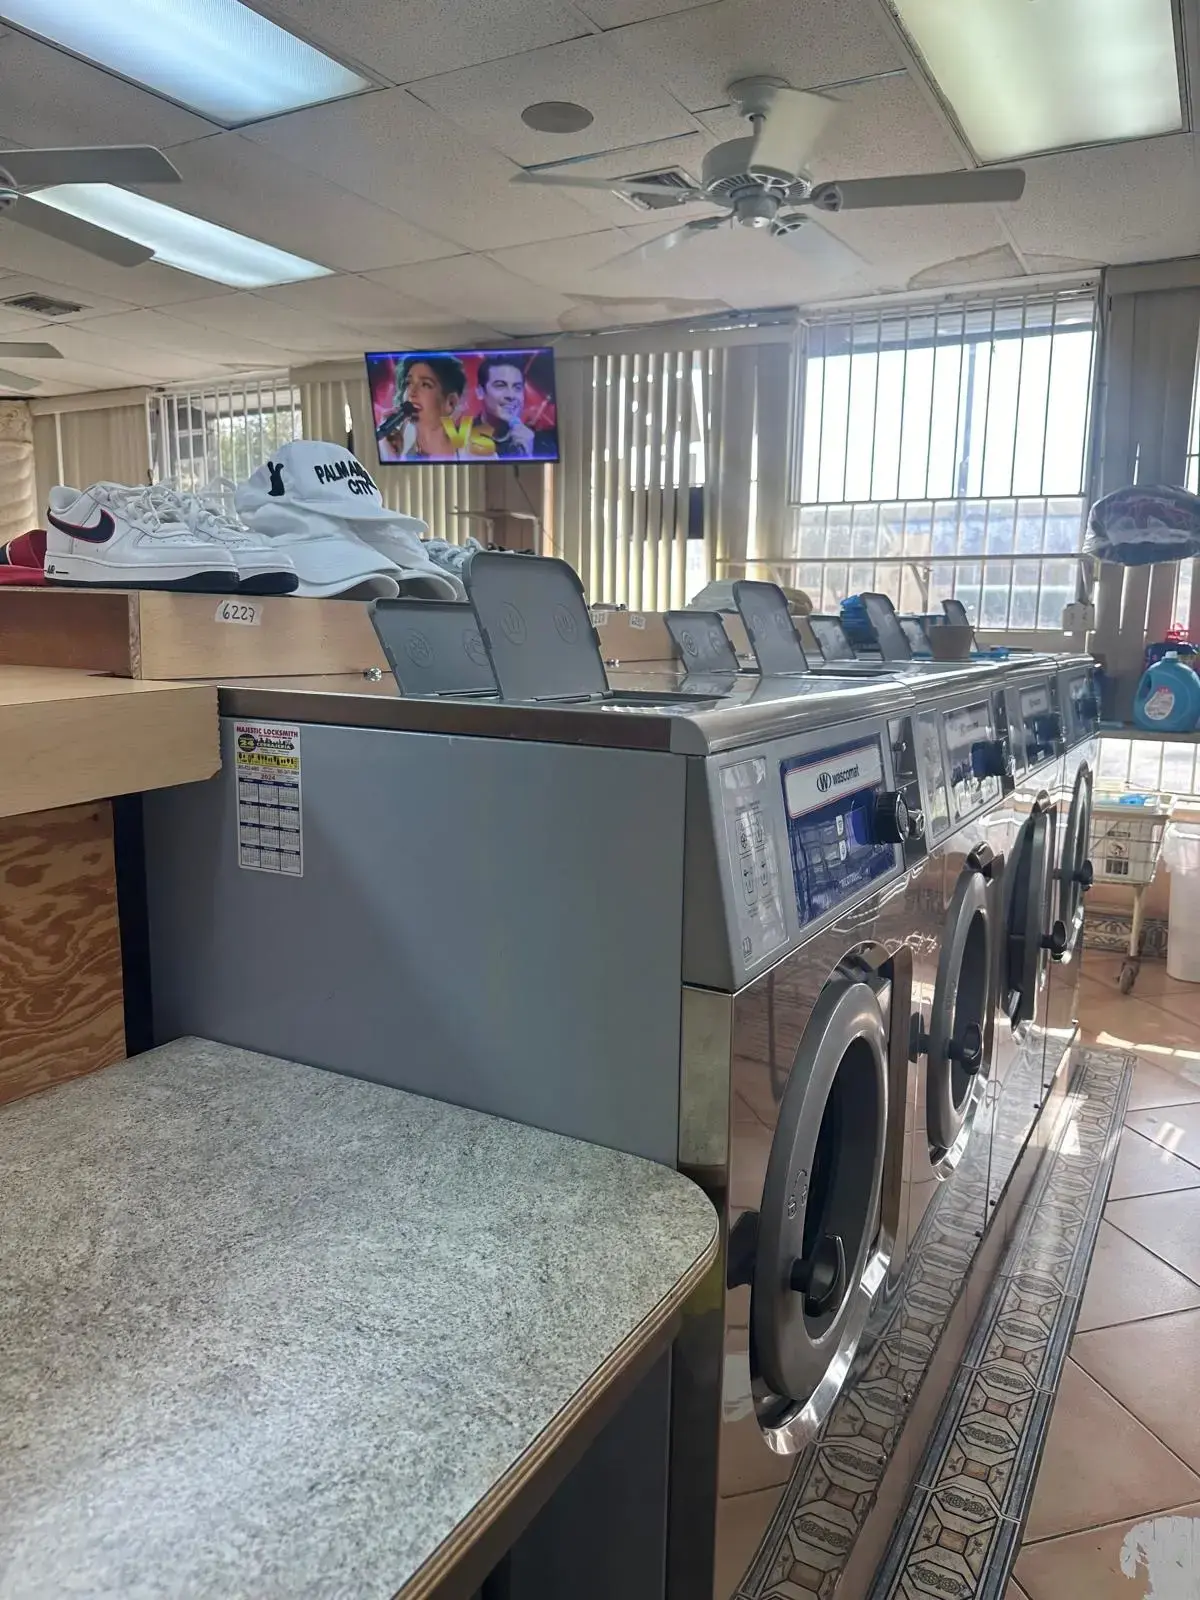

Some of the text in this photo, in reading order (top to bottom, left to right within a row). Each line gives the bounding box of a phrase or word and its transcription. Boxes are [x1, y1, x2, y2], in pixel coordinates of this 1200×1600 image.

[441, 416, 495, 455] VS
[222, 603, 255, 623] 6227
[236, 726, 262, 734] MAJESTIC
[263, 728, 298, 737] LOCKSMITH
[832, 764, 860, 785] wascomat
